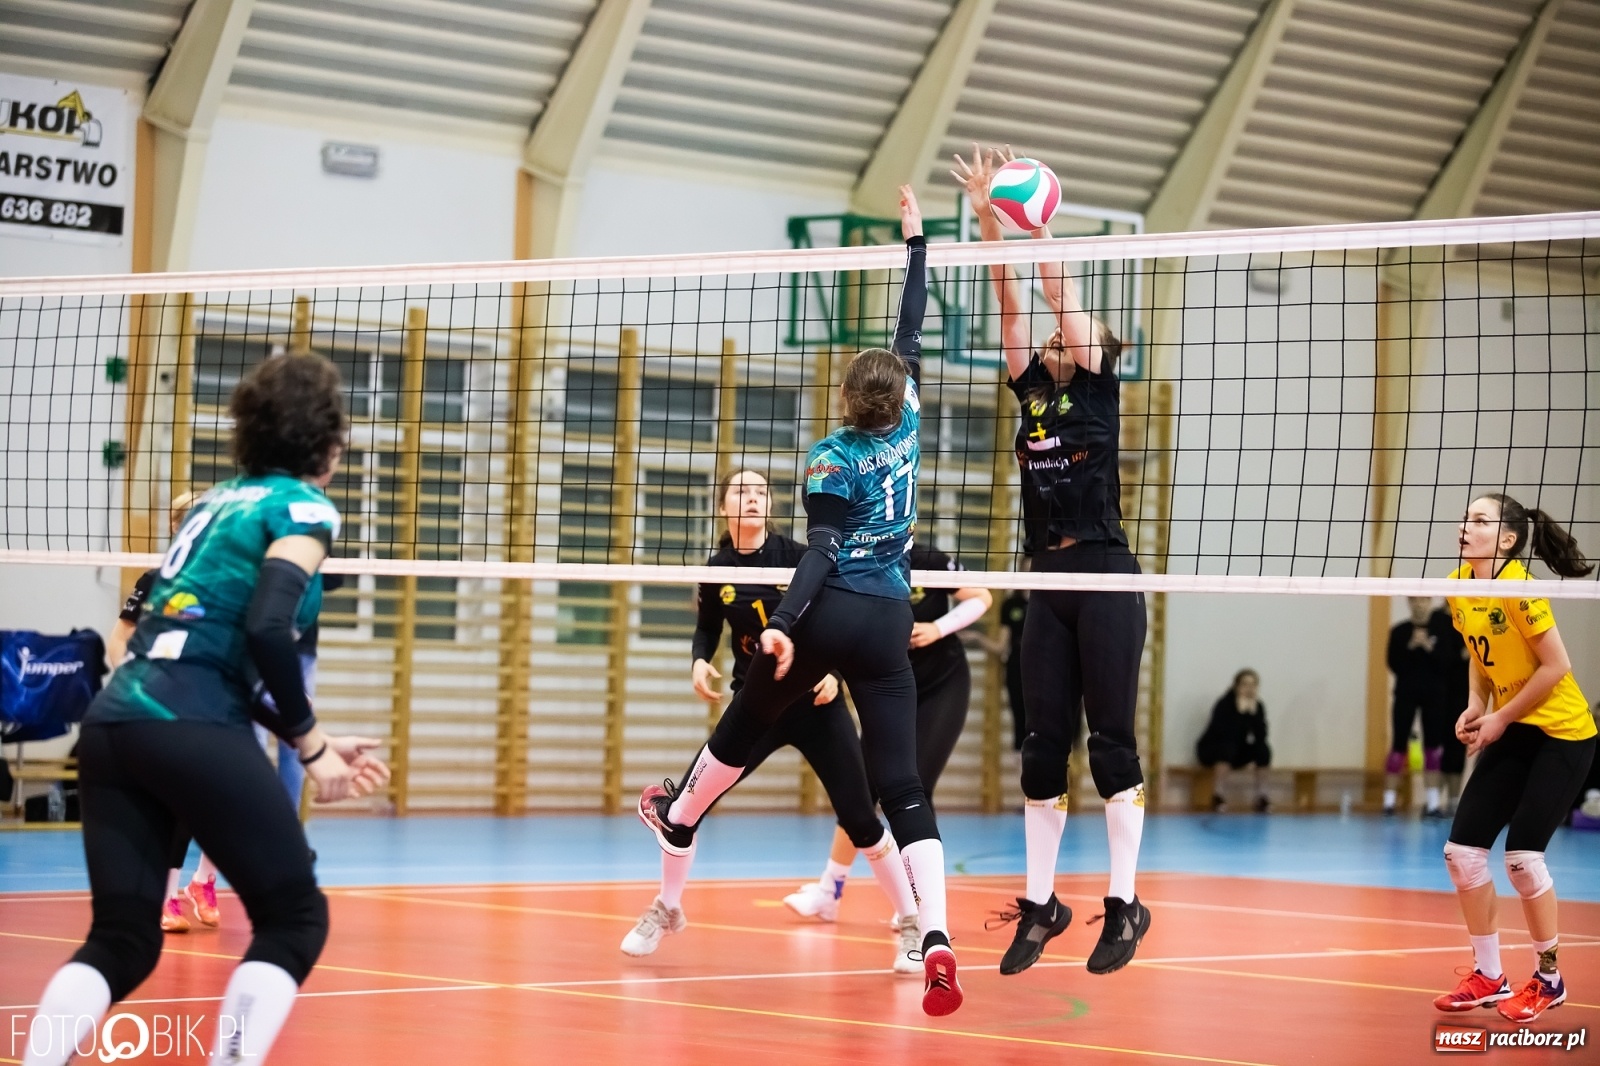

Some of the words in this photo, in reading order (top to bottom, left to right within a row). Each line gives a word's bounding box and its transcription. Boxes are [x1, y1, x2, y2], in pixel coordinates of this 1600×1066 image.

[1, 196, 45, 222] 636
[50, 201, 93, 228] 882
[880, 460, 914, 522] 17
[160, 511, 213, 579] 8
